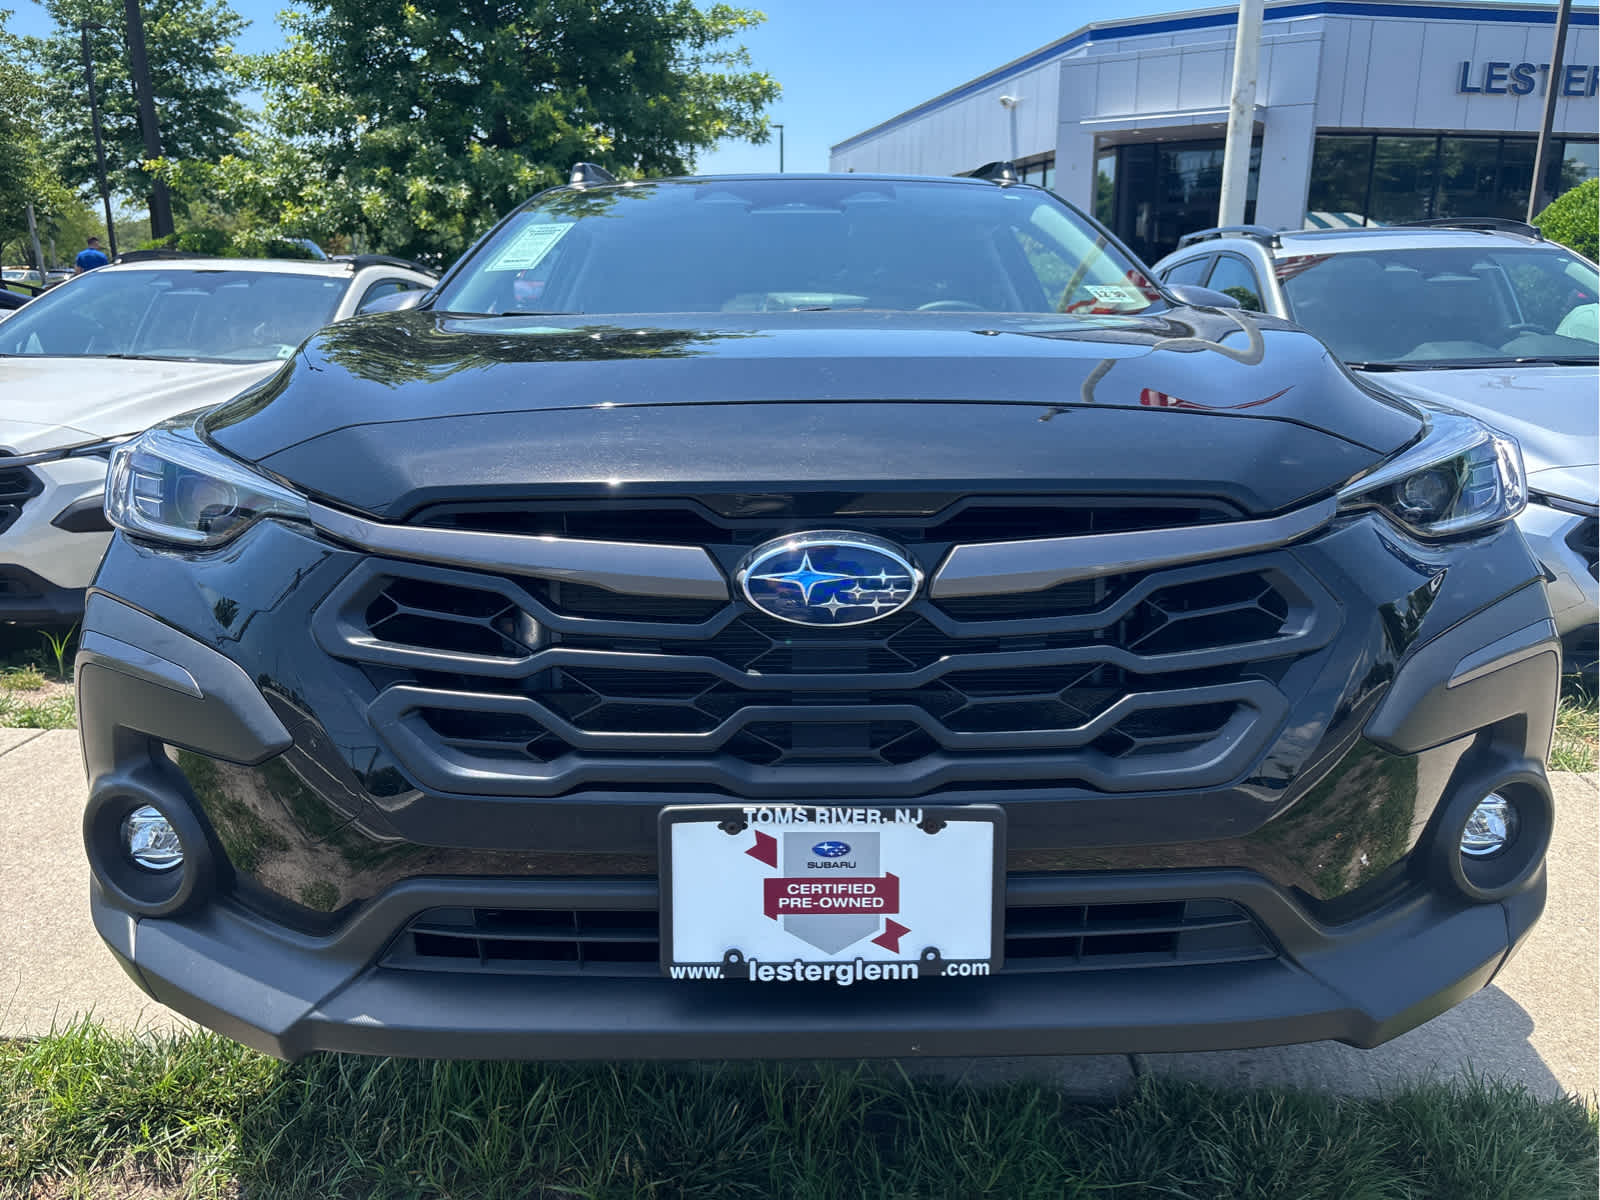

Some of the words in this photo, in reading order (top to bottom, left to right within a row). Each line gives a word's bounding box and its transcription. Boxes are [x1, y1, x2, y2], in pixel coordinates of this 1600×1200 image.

[743, 808, 808, 825] TOMS
[895, 808, 923, 824] NJ
[807, 861, 857, 869] SUBARU
[787, 883, 876, 895] CERTIFIED
[778, 897, 885, 909] PRE-OWNED
[669, 966, 725, 980] www.
[749, 959, 919, 986] lesterglenn
[940, 962, 990, 977] .com
